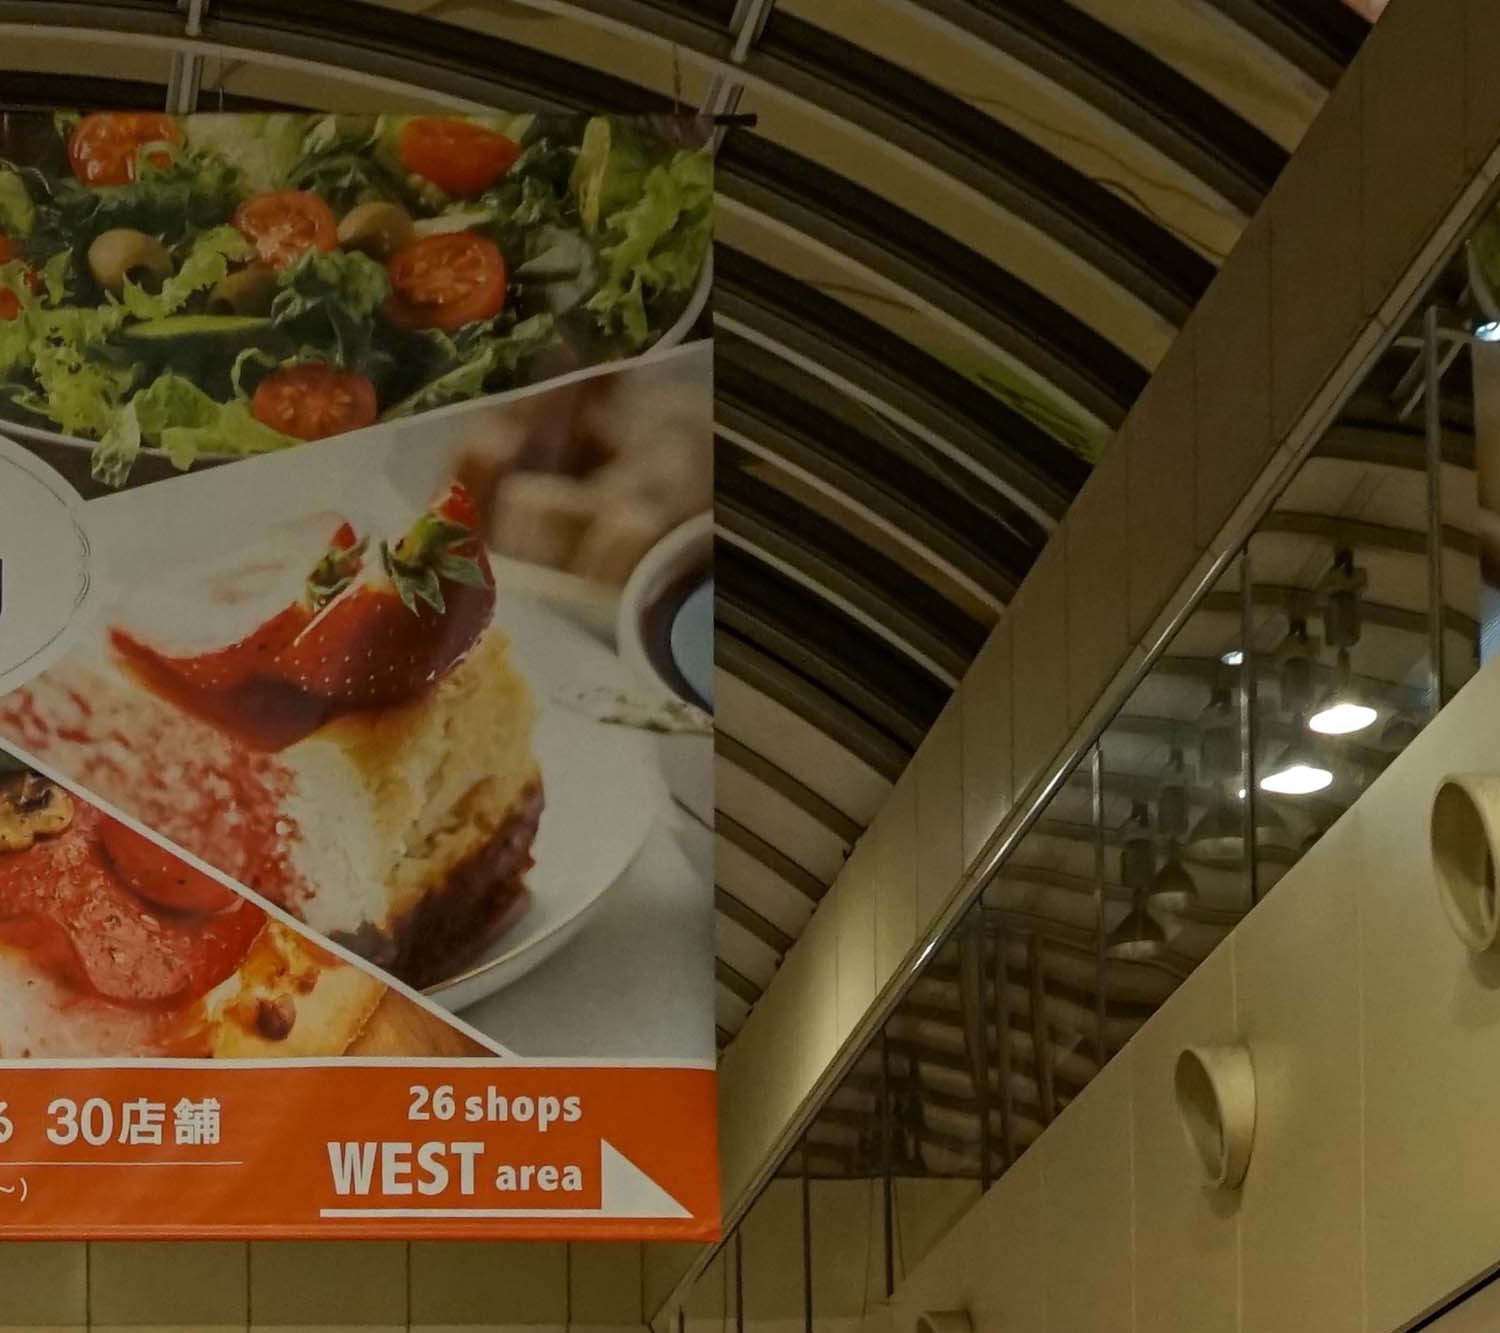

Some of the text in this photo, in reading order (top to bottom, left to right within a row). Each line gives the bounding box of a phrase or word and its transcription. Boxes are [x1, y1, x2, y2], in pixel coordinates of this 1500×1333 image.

[46, 1096, 222, 1147] 30店舗
[407, 1085, 583, 1133] 26 shops
[326, 1141, 583, 1196] WEST area
